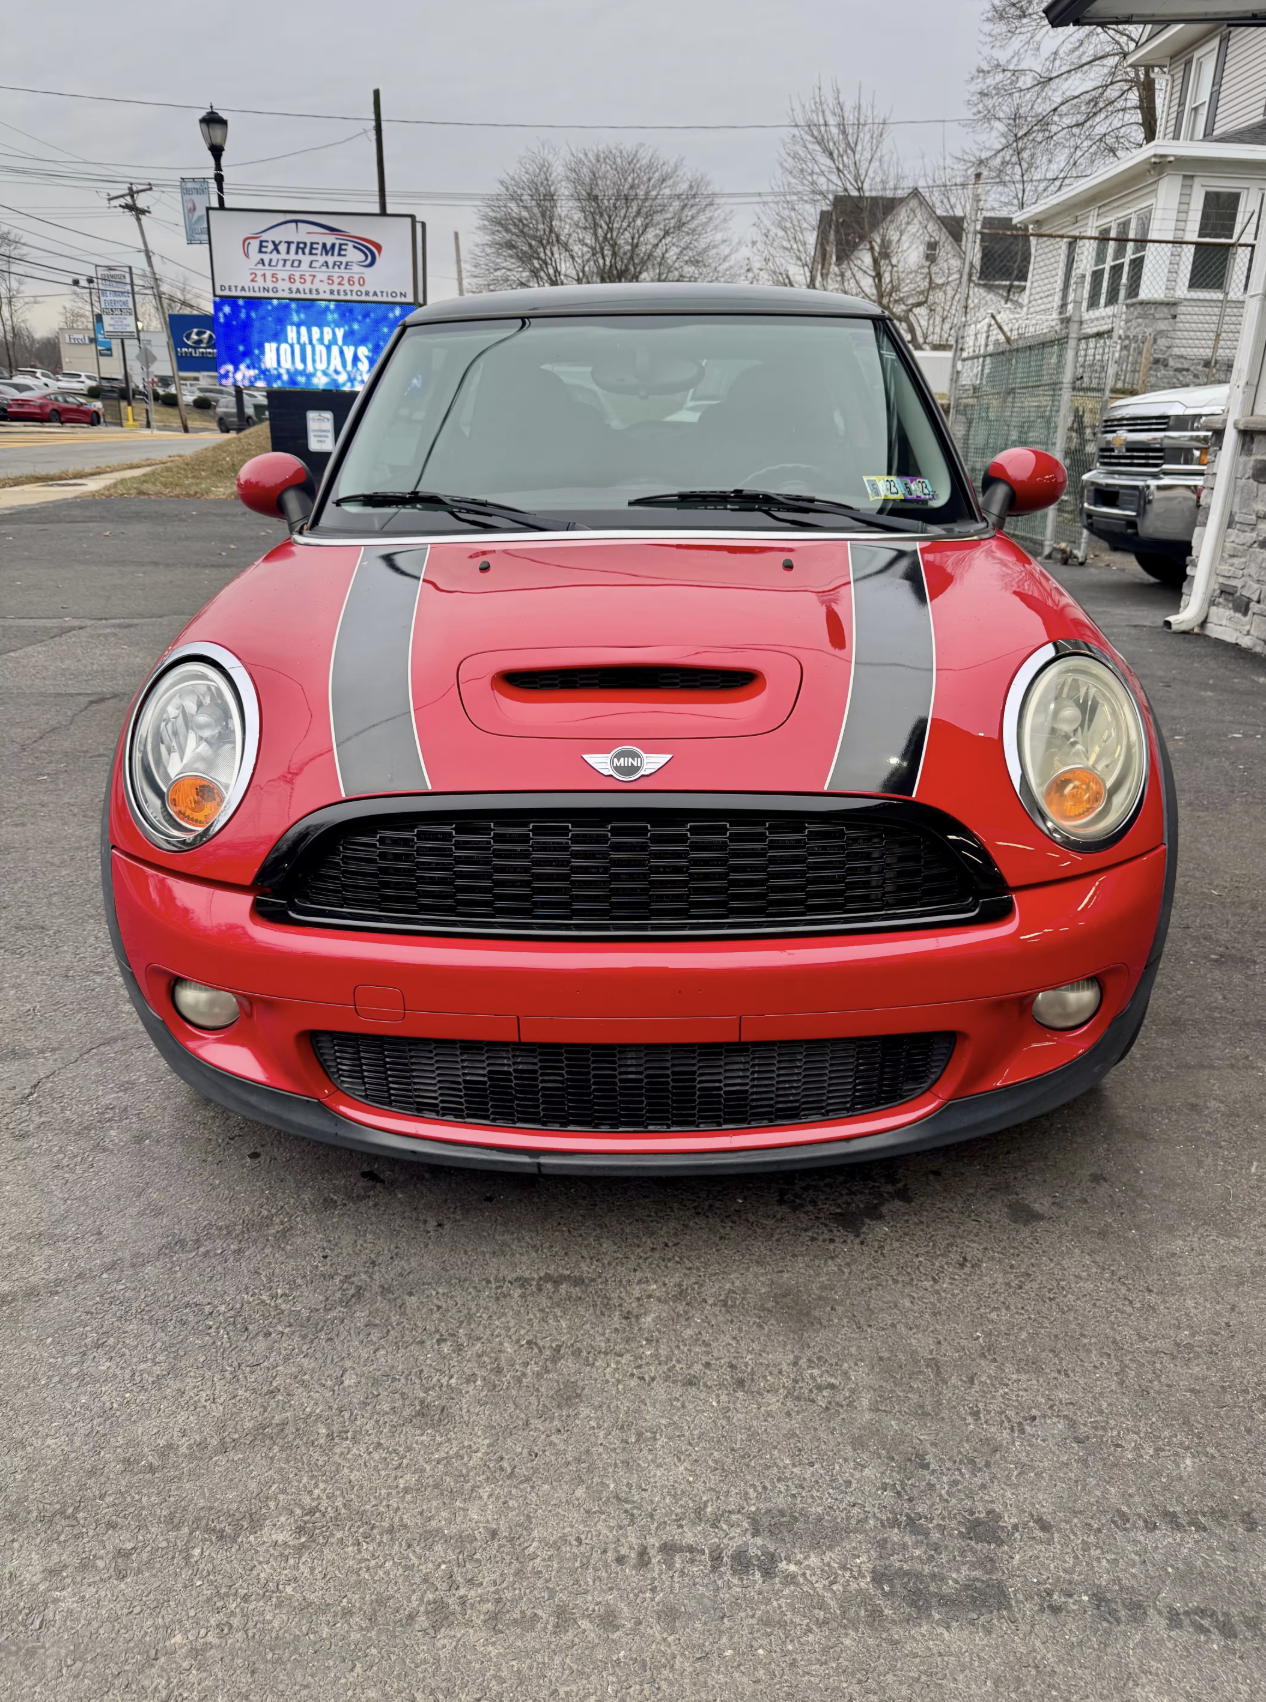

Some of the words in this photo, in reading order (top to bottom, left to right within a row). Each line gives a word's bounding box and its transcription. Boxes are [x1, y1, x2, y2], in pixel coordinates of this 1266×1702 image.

[257, 239, 349, 257] EXTREME
[254, 257, 302, 269] AUTO
[308, 258, 355, 271] CARE
[249, 272, 366, 287] 215-657-5260
[220, 284, 279, 294] DETAILING
[288, 287, 321, 296] SALES
[329, 288, 407, 299] RESTORATION
[68, 334, 86, 343] Fred
[287, 325, 345, 346] HAPPY
[177, 347, 217, 358] HYUND
[264, 342, 370, 373] HOLIDAYS
[613, 757, 641, 767] MINI
